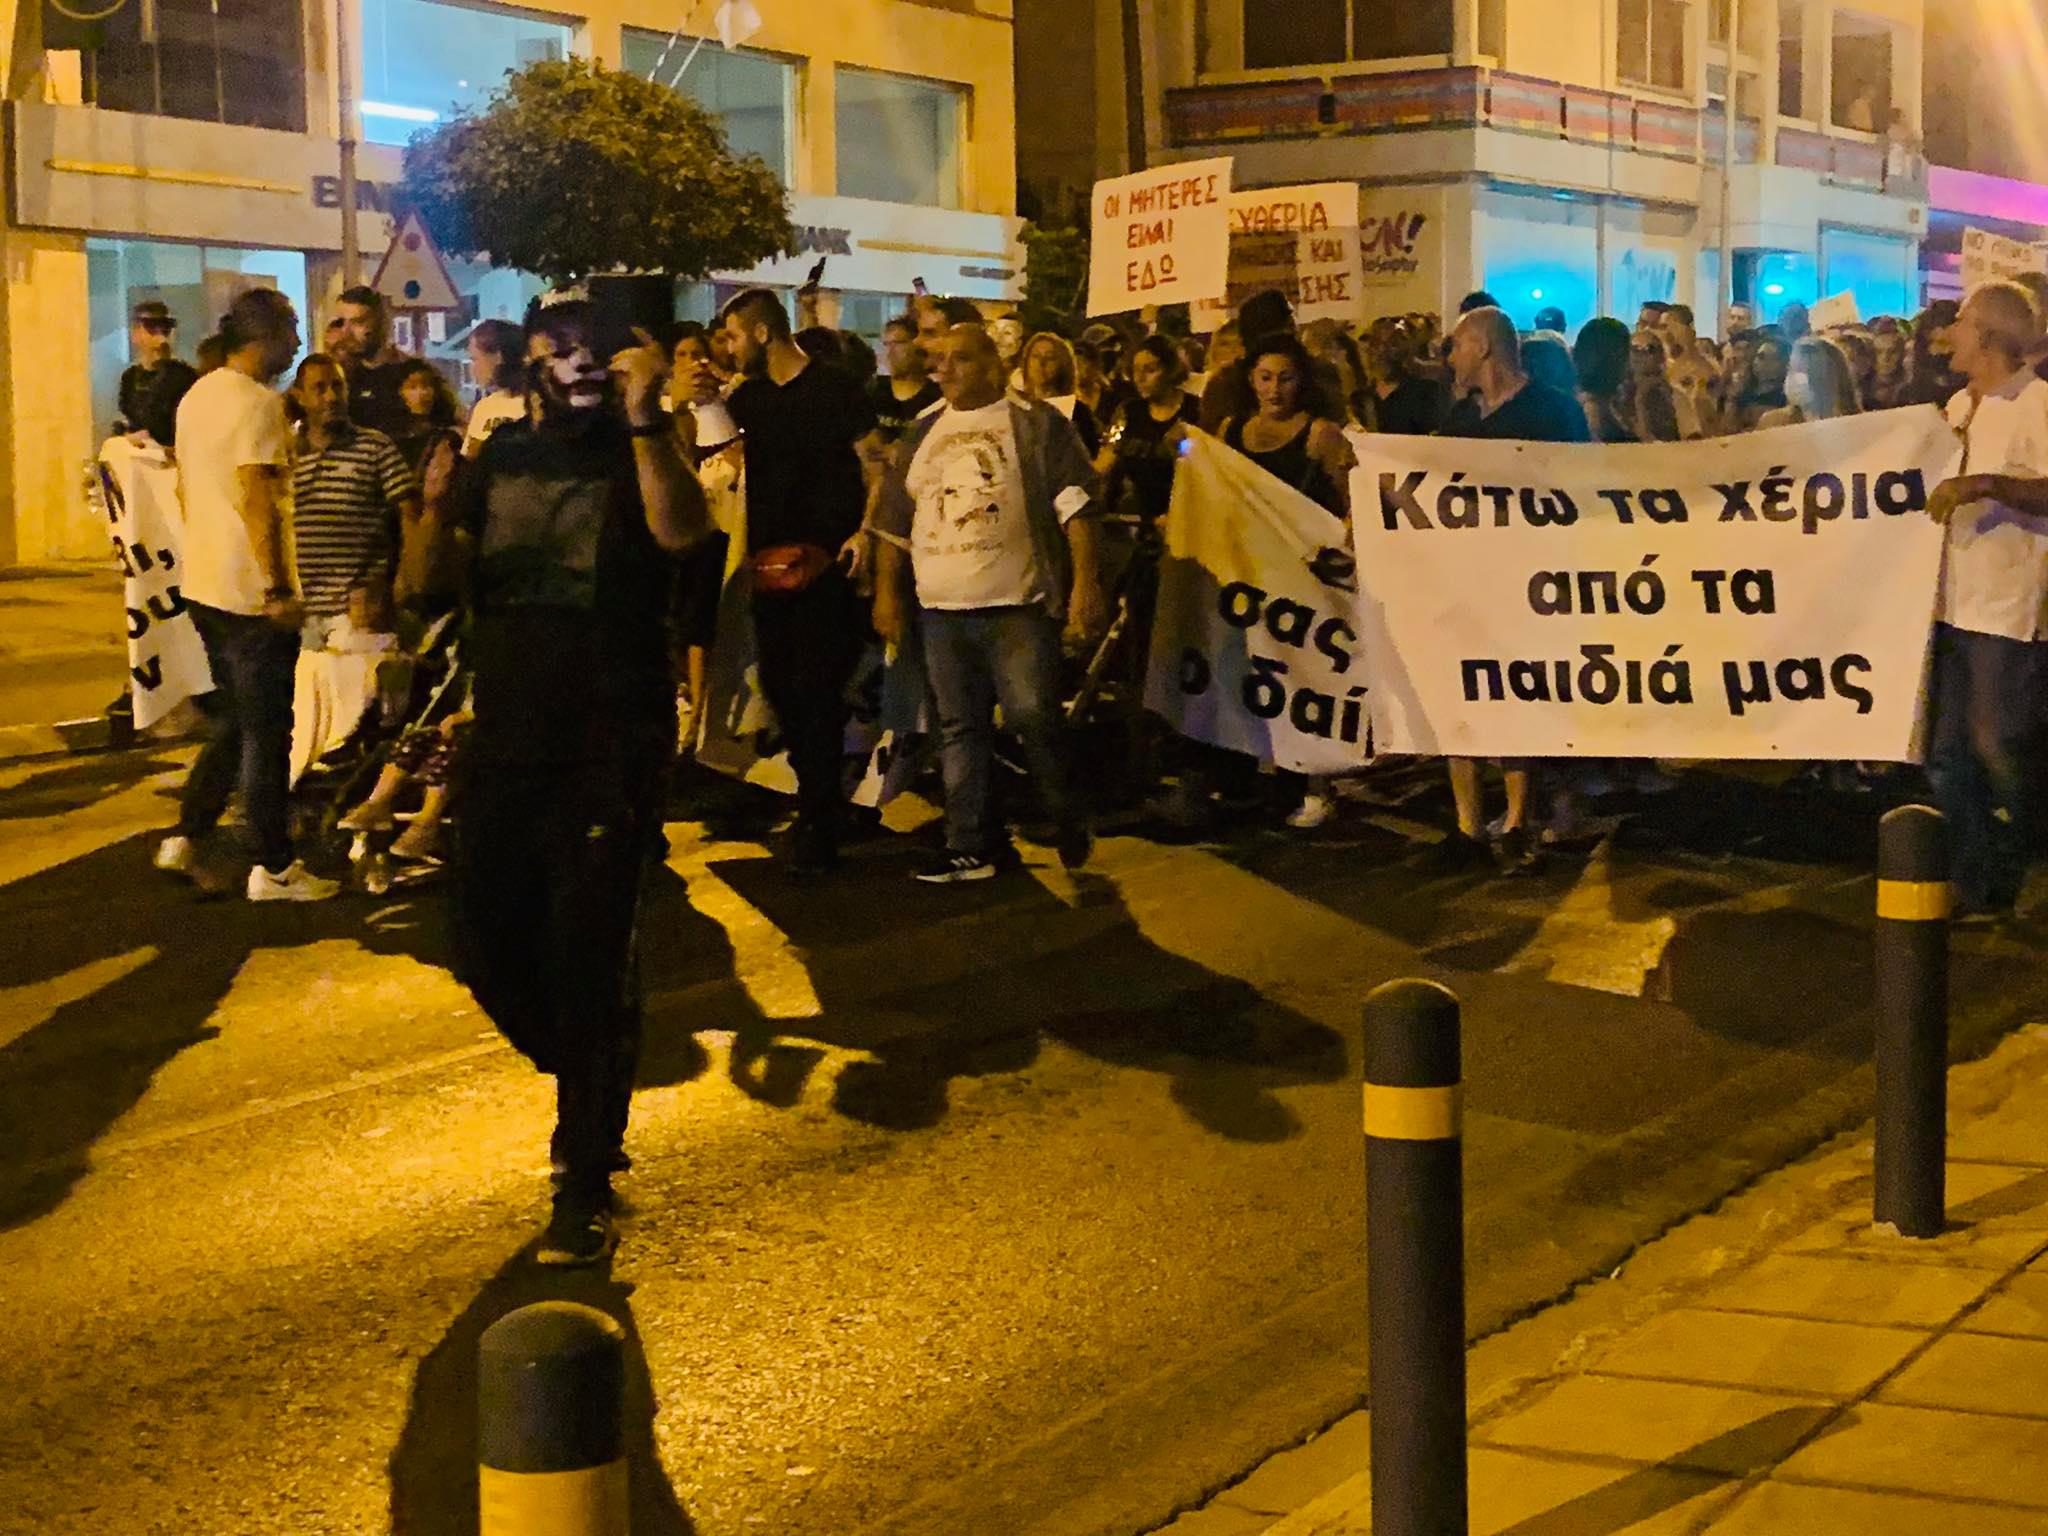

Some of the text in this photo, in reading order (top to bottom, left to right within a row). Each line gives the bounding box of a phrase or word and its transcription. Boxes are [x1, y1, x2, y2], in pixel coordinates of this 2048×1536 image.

[1129, 175, 1219, 215] ΜΗΤΕΡΕΣ
[1229, 201, 1329, 234] ΥΘΕΡΙΑ
[1127, 253, 1178, 292] ΕΔΩ
[1379, 465, 1927, 534] Κάτω τα χέρια
[1527, 554, 1776, 616] από τα
[1219, 581, 1357, 674] σας
[1242, 654, 1375, 759] δαί
[1461, 643, 1874, 716] παιδιά μας
